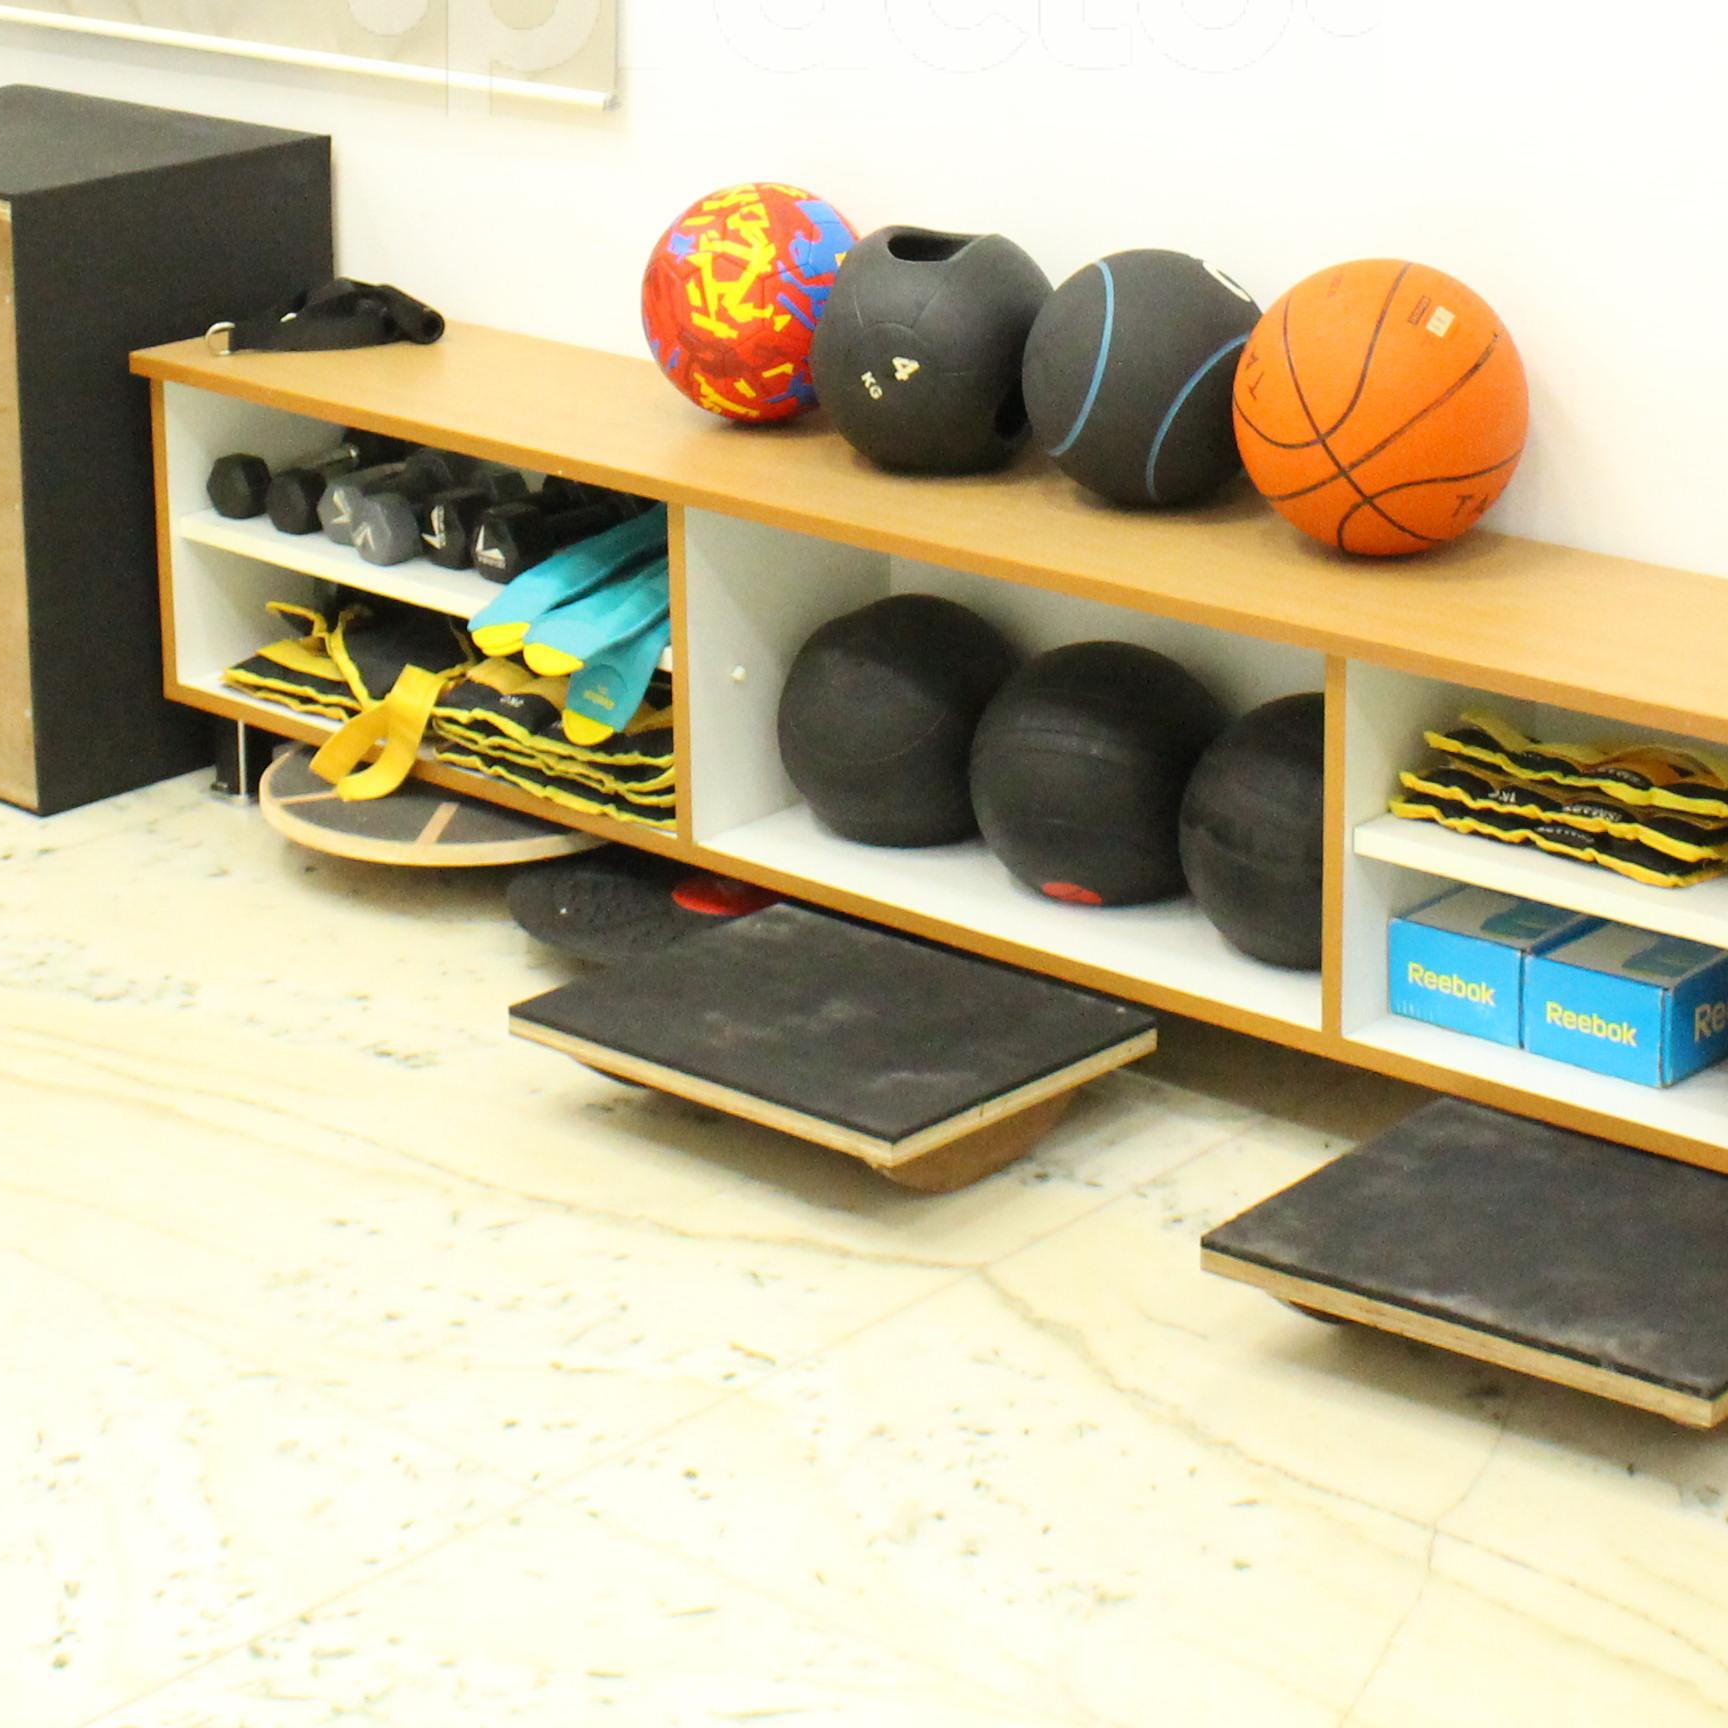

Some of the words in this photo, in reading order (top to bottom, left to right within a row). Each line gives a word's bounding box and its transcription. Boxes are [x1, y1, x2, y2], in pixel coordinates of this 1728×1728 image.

[860, 370, 883, 400] KG
[891, 356, 920, 382] 4
[1407, 960, 1496, 1008] Reebok
[1545, 1000, 1638, 1047] Reebok
